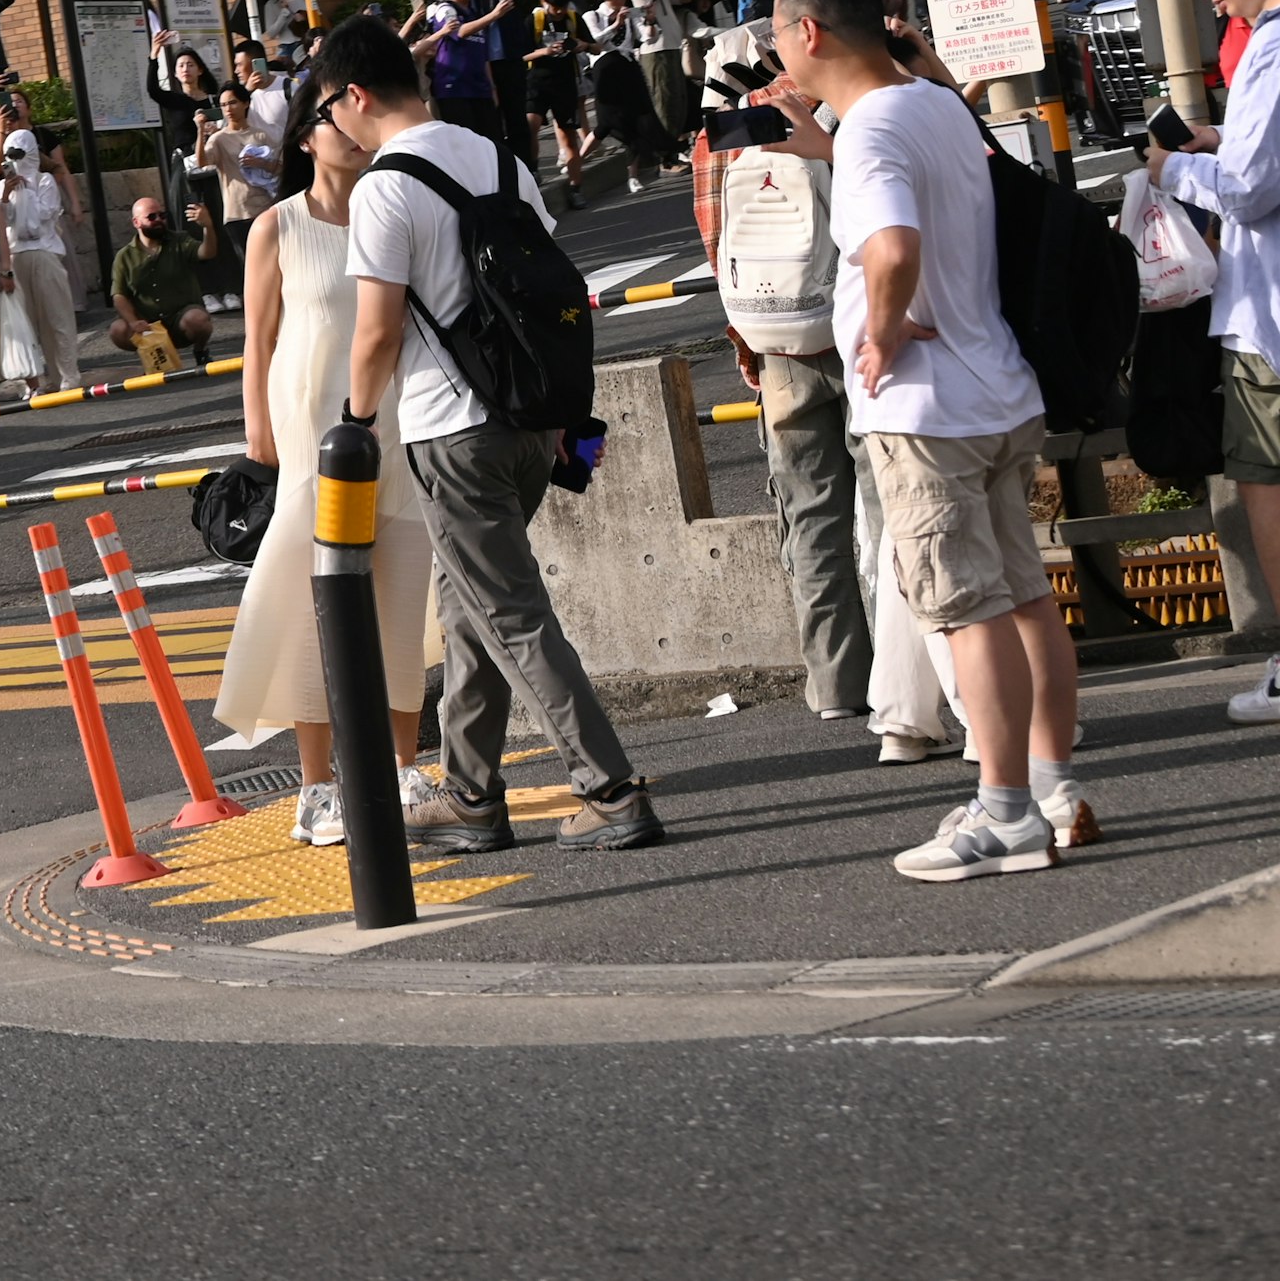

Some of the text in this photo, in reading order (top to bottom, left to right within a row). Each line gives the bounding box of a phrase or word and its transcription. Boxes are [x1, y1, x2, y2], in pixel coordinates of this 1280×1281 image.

[944, 36, 976, 48] 紧急按钮
[969, 59, 1016, 76] 监控录像中
